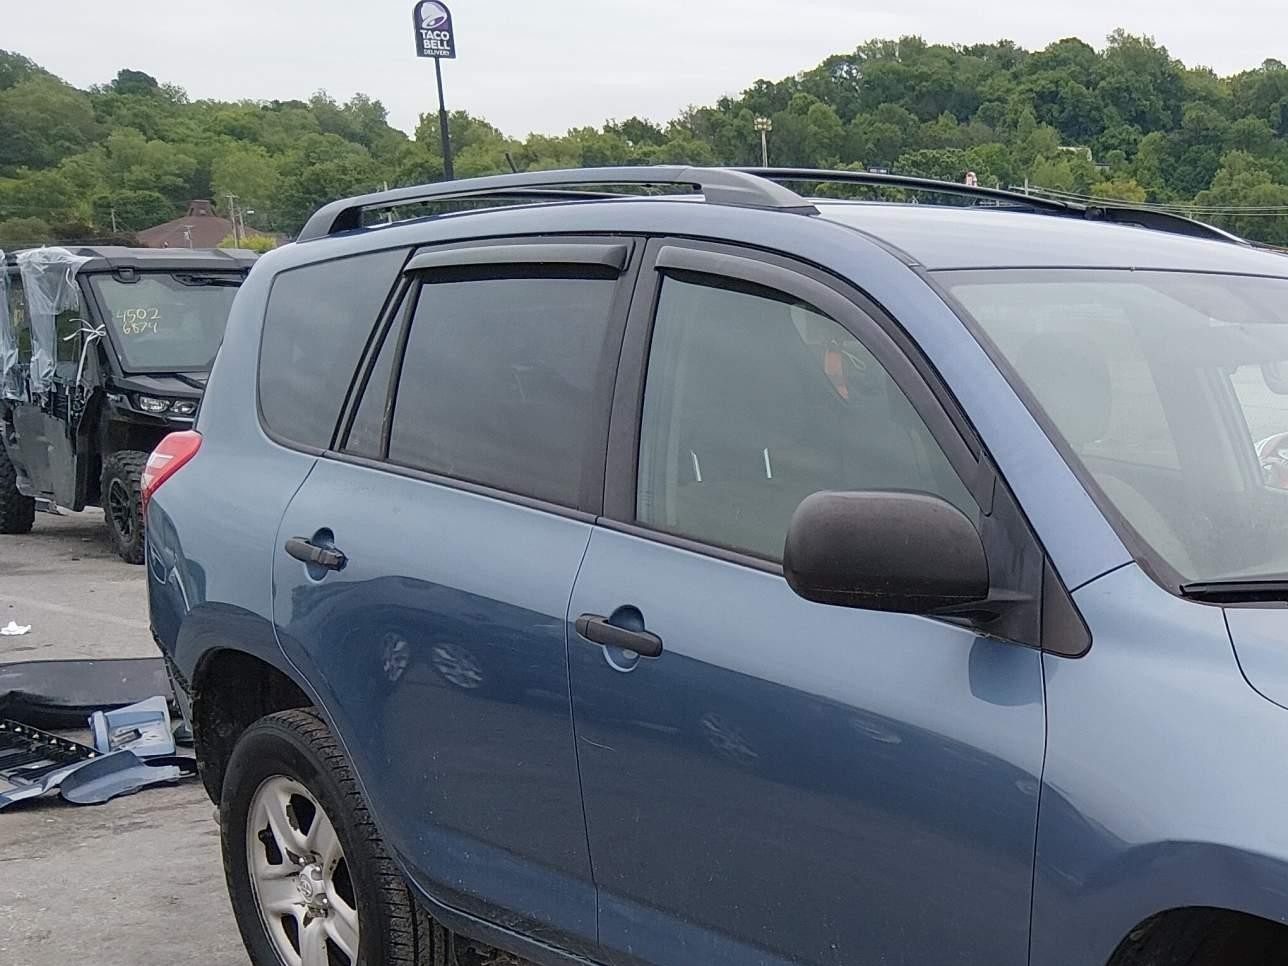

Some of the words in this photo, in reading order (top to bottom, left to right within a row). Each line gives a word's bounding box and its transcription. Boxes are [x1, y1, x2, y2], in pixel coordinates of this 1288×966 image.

[420, 30, 450, 40] TACO
[423, 40, 450, 50] BELL
[116, 307, 161, 323] 4502
